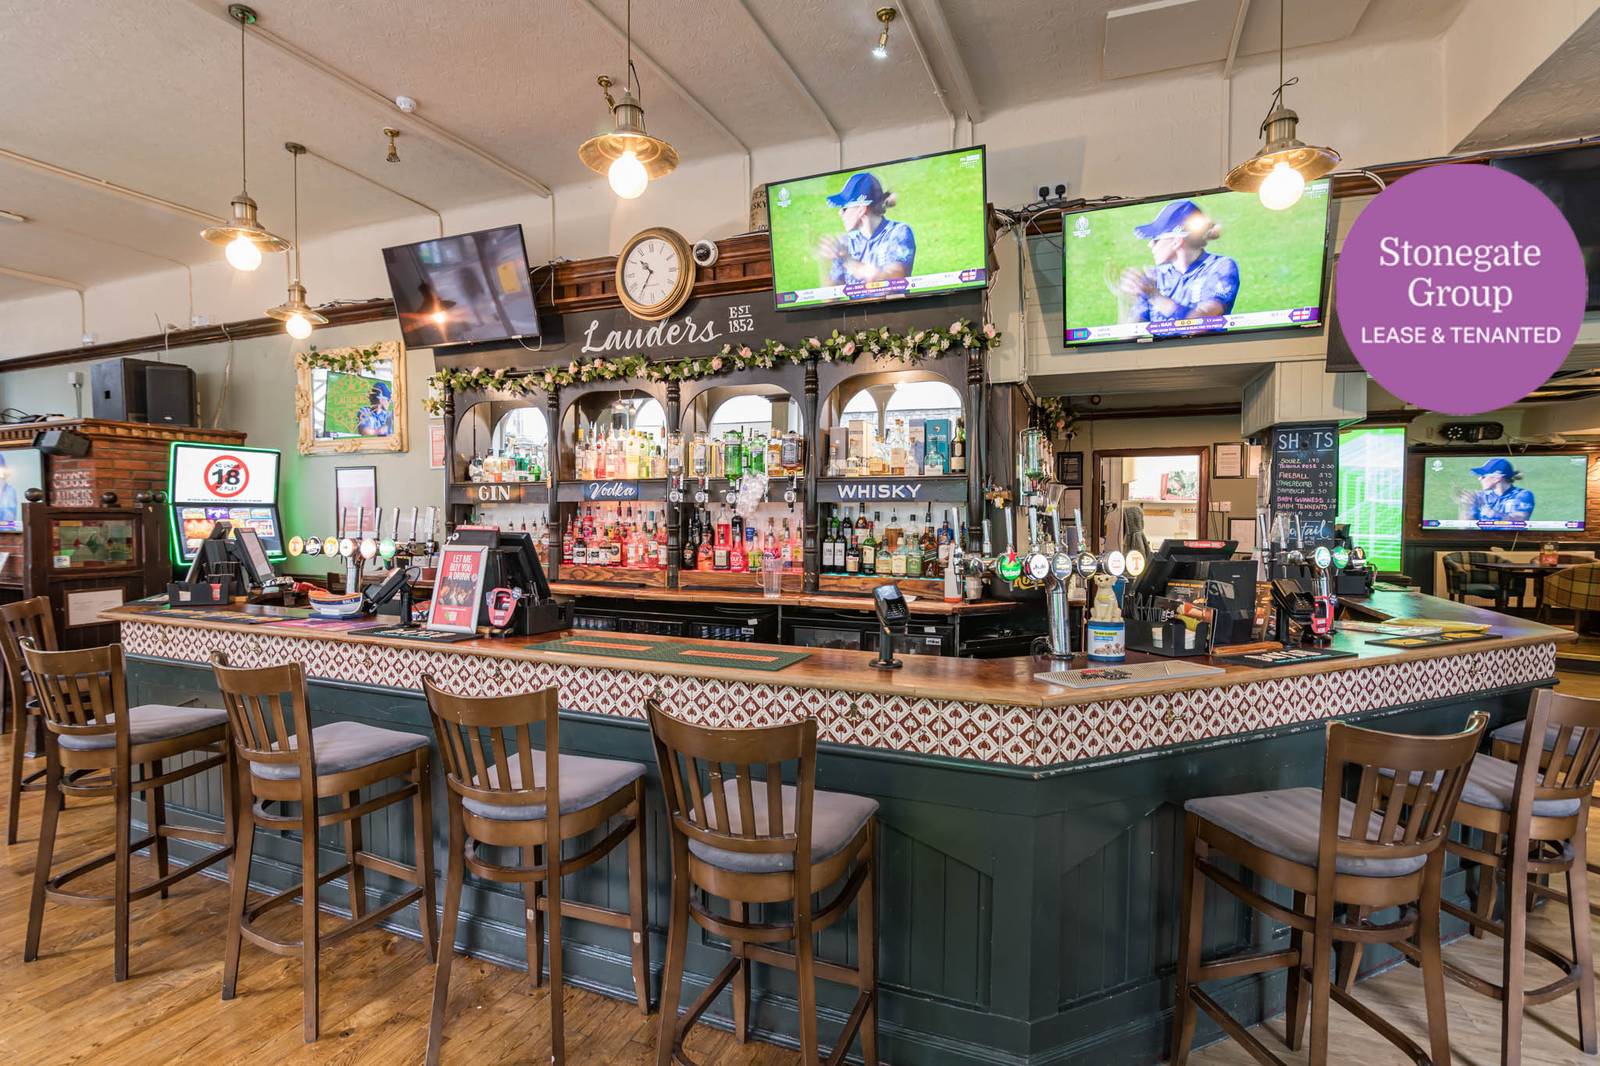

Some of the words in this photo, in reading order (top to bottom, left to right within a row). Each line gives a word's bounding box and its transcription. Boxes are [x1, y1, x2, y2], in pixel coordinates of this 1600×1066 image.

[728, 305, 752, 319] EST
[728, 319, 754, 333] 1852
[581, 316, 723, 353] Lauders
[1278, 432, 1334, 450] SHTS
[212, 469, 240, 485] 18
[1279, 472, 1310, 480] FIREBALL
[478, 485, 511, 501] GIN
[589, 483, 636, 500] Vodka
[837, 484, 921, 499] WHISKY
[453, 554, 463, 562] LET
[461, 563, 472, 572] YOU
